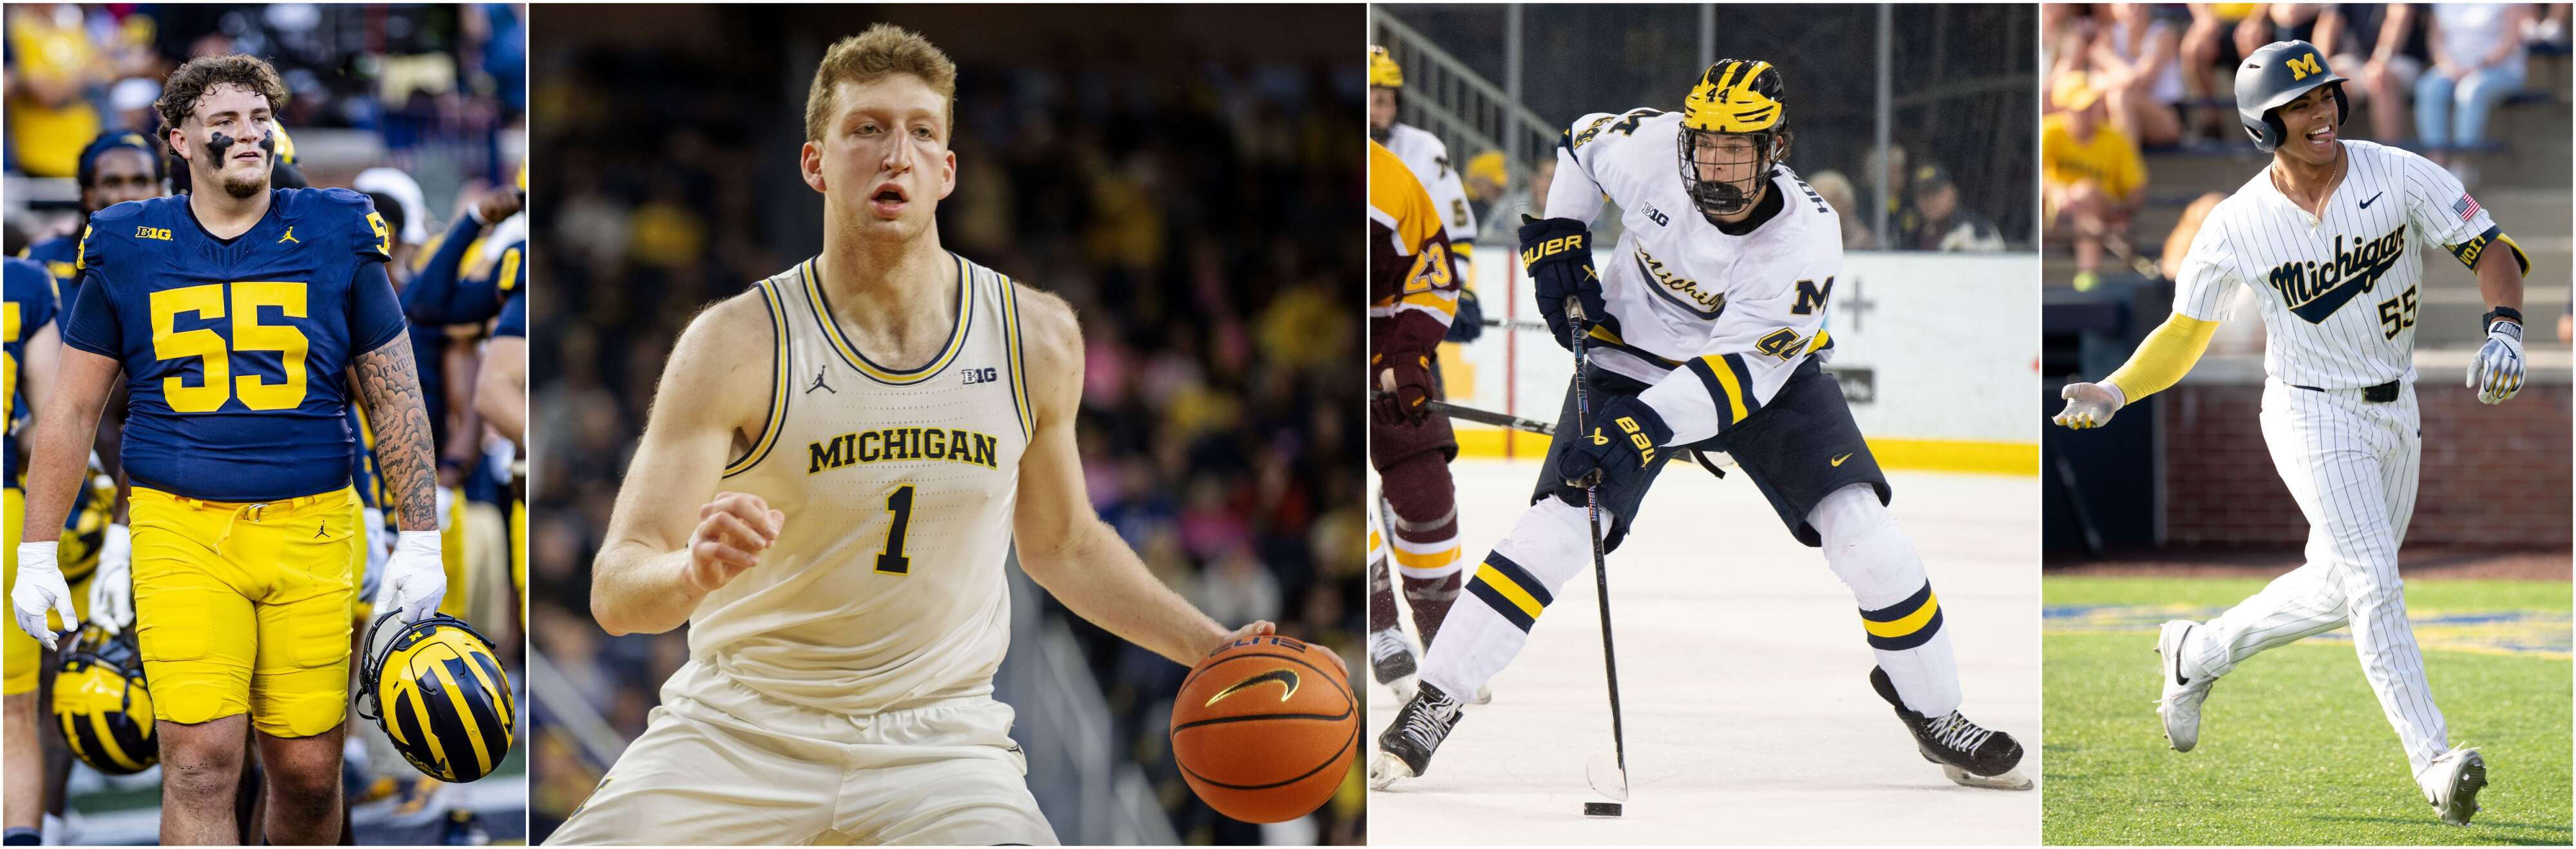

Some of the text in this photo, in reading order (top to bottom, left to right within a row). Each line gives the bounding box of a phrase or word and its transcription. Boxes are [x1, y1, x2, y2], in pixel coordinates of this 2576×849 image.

[2286, 53, 2322, 81] M
[1707, 87, 1730, 104] 44
[1404, 241, 1452, 294] 23
[2269, 223, 2406, 309] Michigan
[2378, 284, 2417, 341] 55
[149, 281, 309, 413] 55
[807, 427, 998, 476] MICHIGAN
[874, 484, 916, 576] 1
